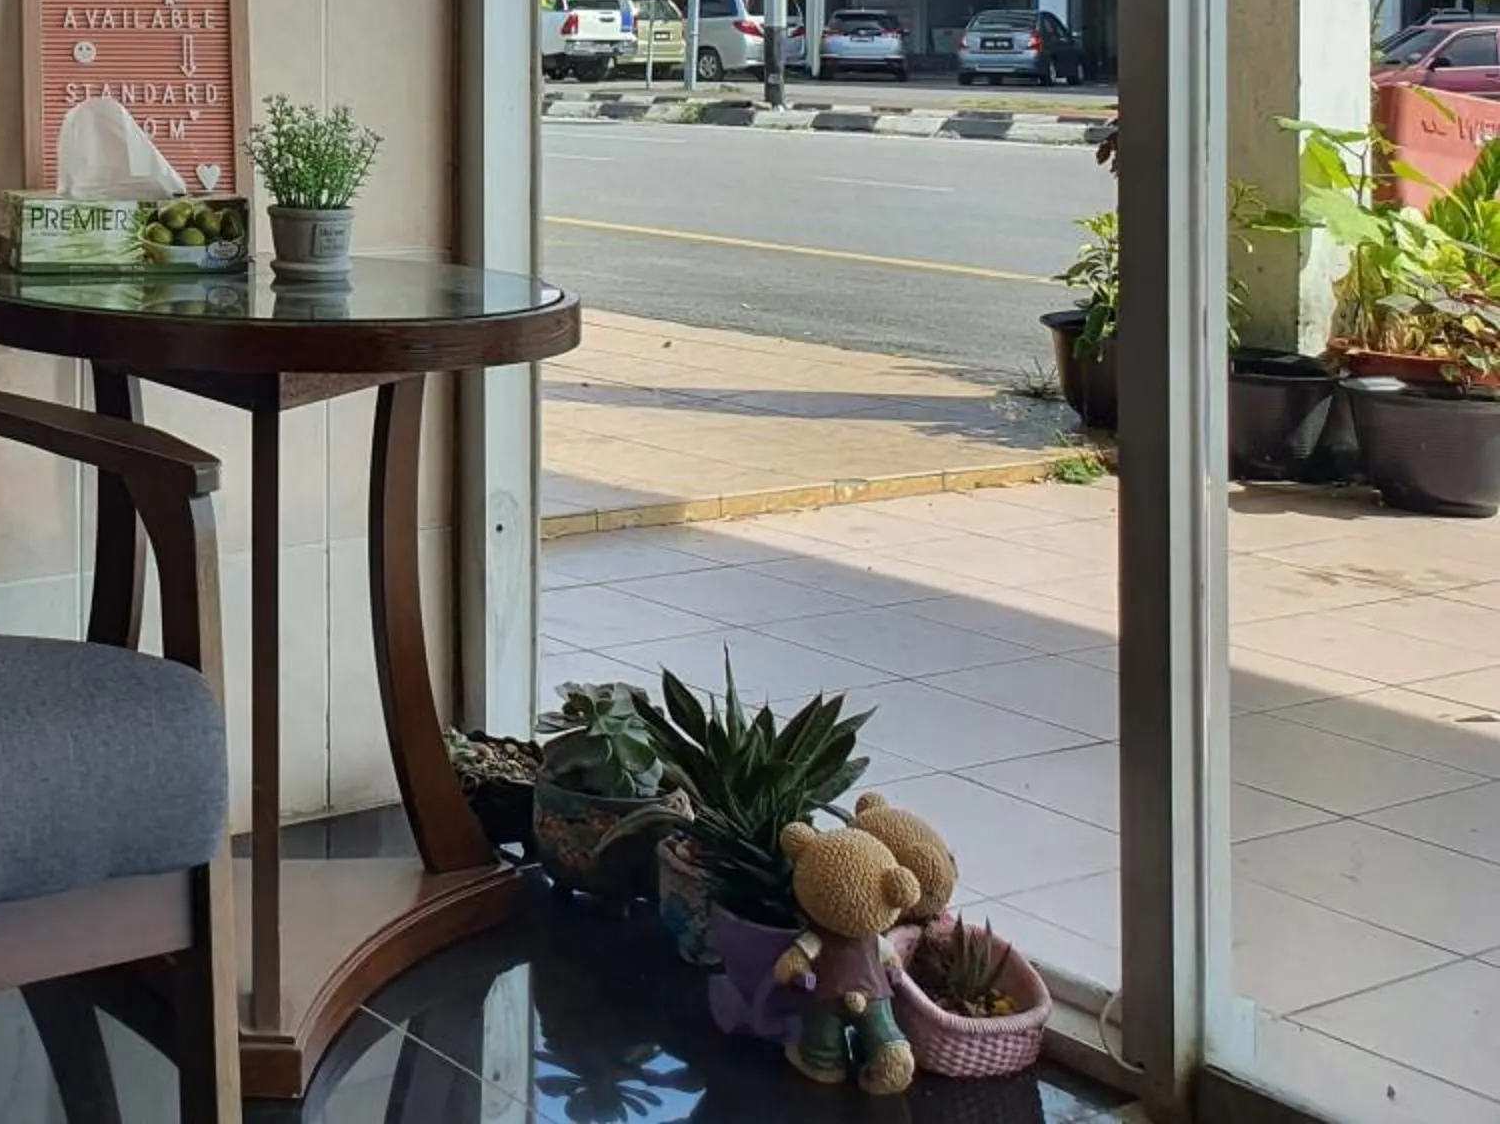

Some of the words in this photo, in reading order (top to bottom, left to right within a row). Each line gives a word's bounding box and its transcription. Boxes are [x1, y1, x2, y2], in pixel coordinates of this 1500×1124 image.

[63, 7, 216, 29] AVAILABLE
[65, 82, 218, 105] STANDARD
[30, 206, 128, 232] PREMIER
